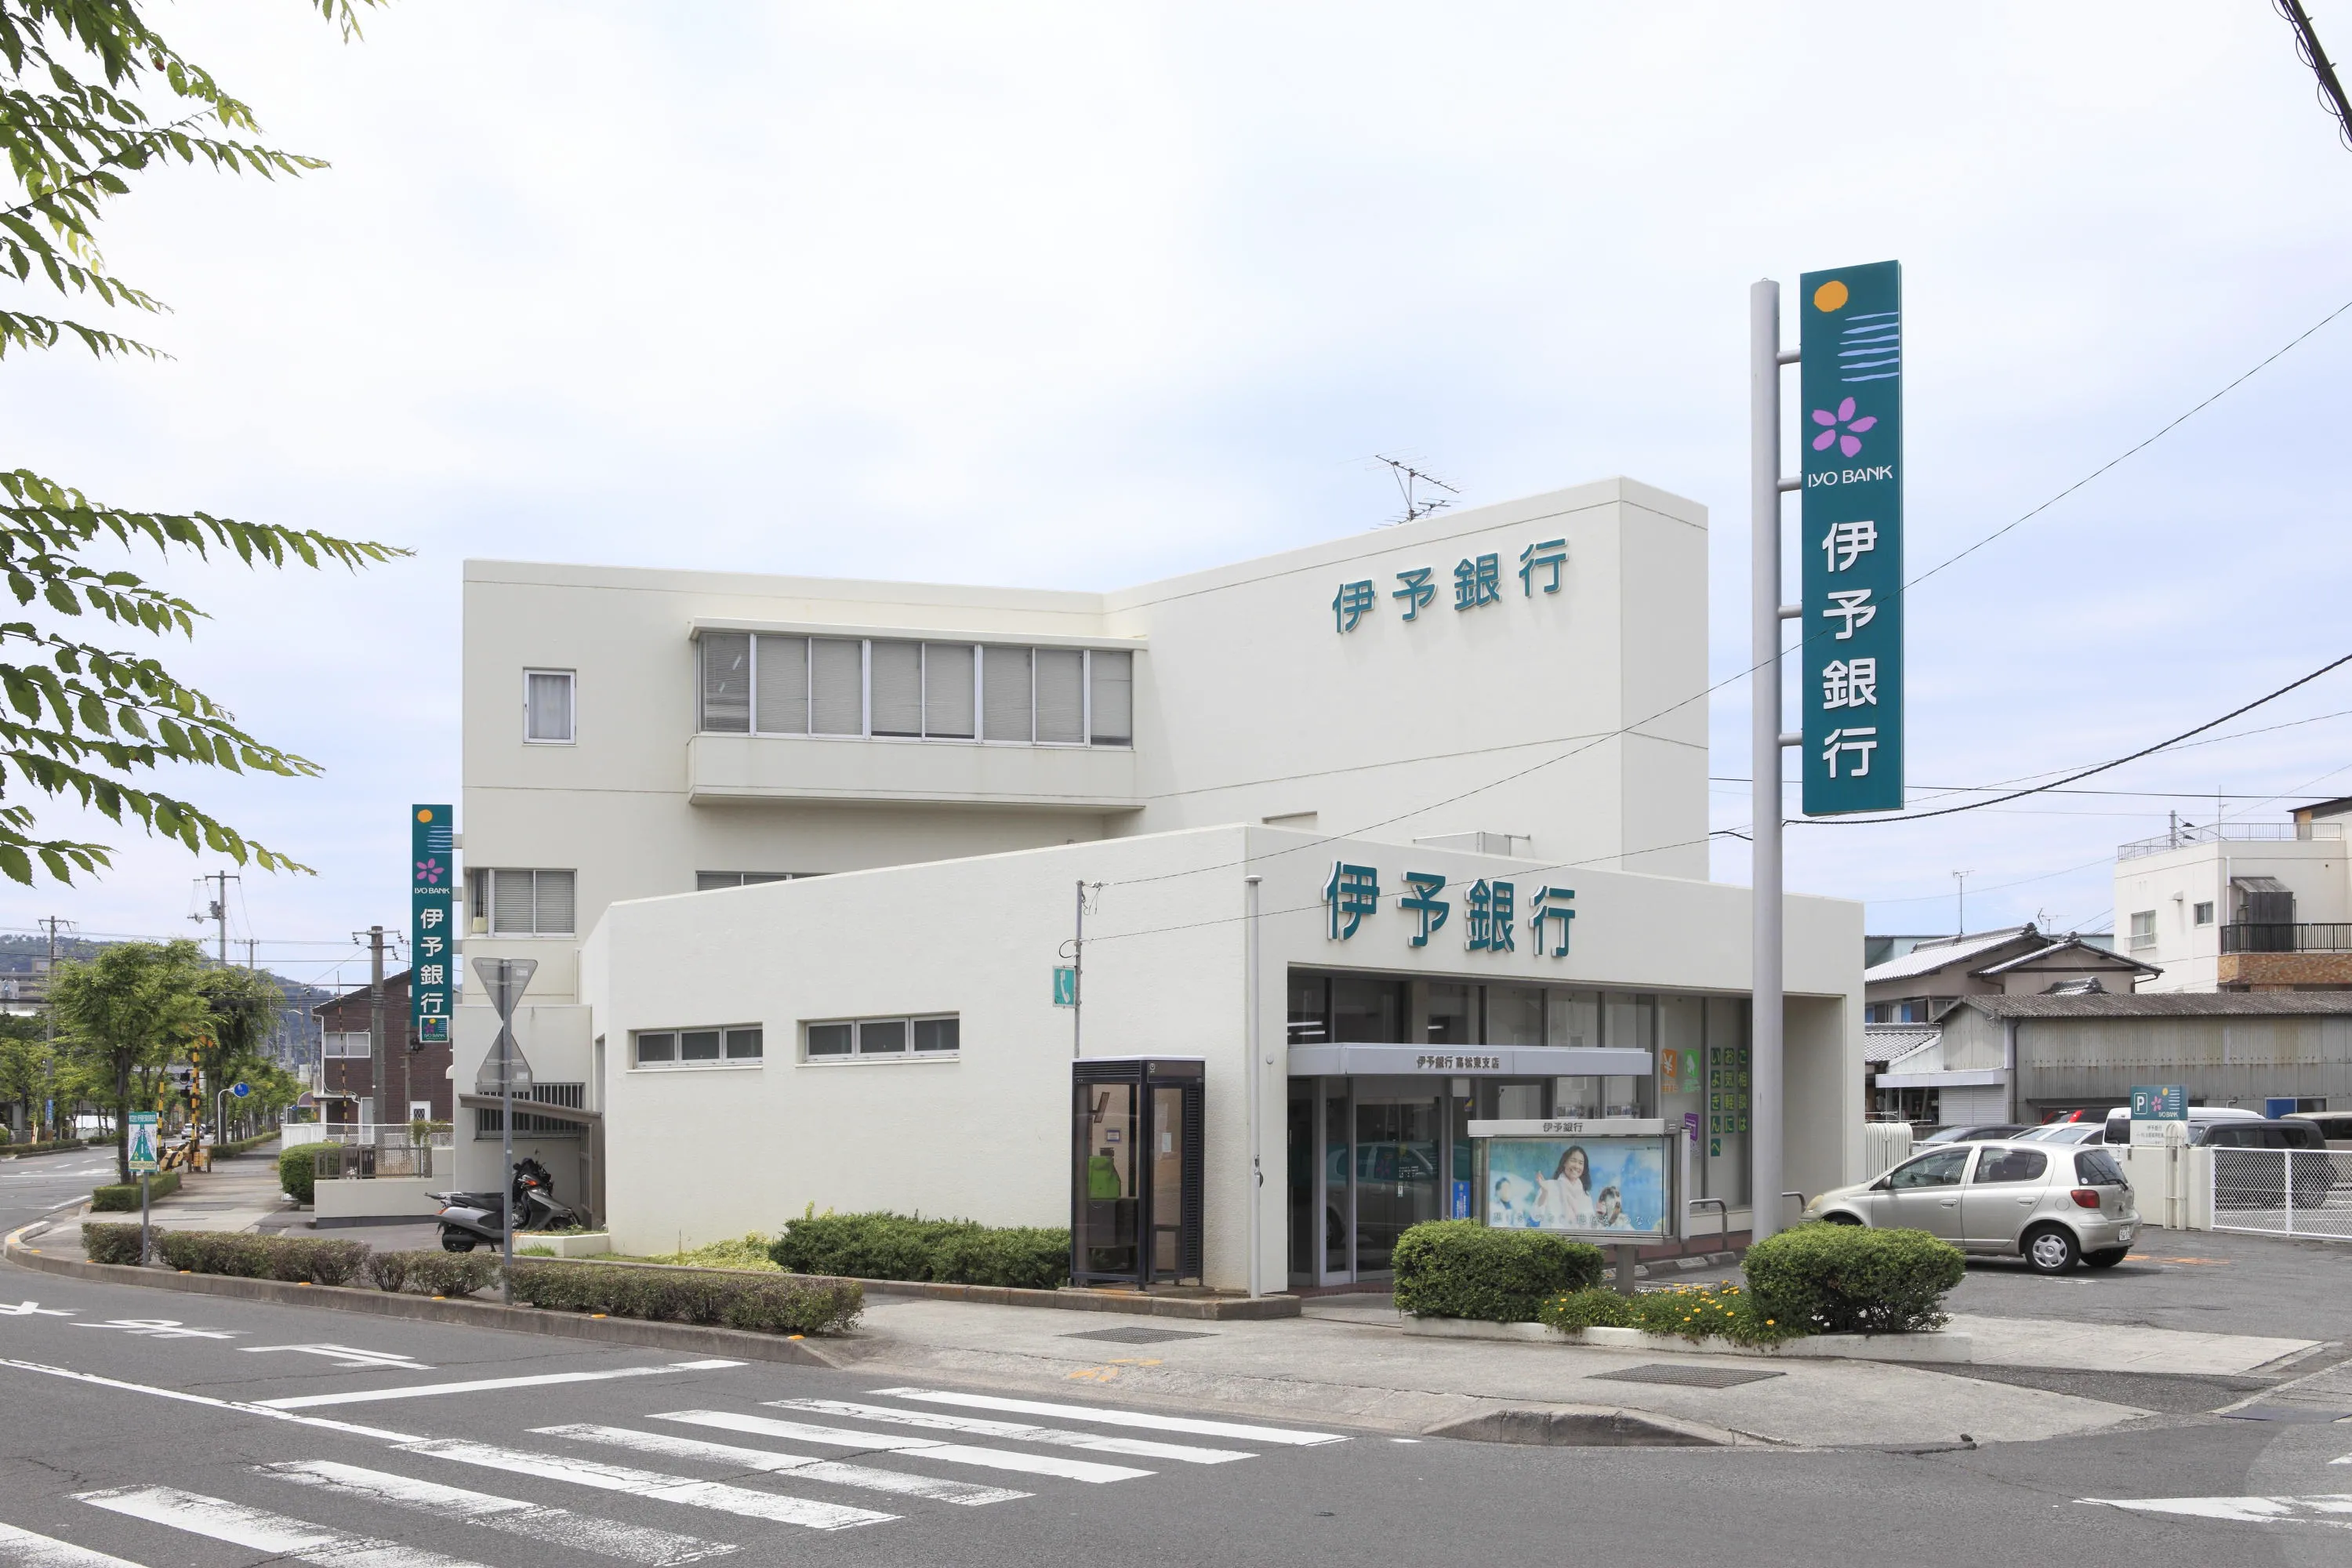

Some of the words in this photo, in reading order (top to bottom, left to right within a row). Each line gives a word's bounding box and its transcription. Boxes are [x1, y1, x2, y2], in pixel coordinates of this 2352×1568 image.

[1807, 471, 1838, 488] IYO
[1842, 464, 1893, 485] BANK
[1332, 538, 1569, 633] 伊予銀行
[1821, 519, 1878, 780] 伊予銀行
[1322, 861, 1577, 958] 伊予銀行
[420, 908, 445, 1014] 伊予銀行
[1417, 1055, 1454, 1069] 伊予銀行
[1455, 1056, 1500, 1069] 高松東支店
[1711, 1049, 1721, 1152] いよぎんへ
[1724, 1049, 1735, 1131] お気軽に
[1738, 1049, 1748, 1131] ご相談は
[1543, 1122, 1584, 1132] 伊予銀行
[2136, 1095, 2145, 1112] P
